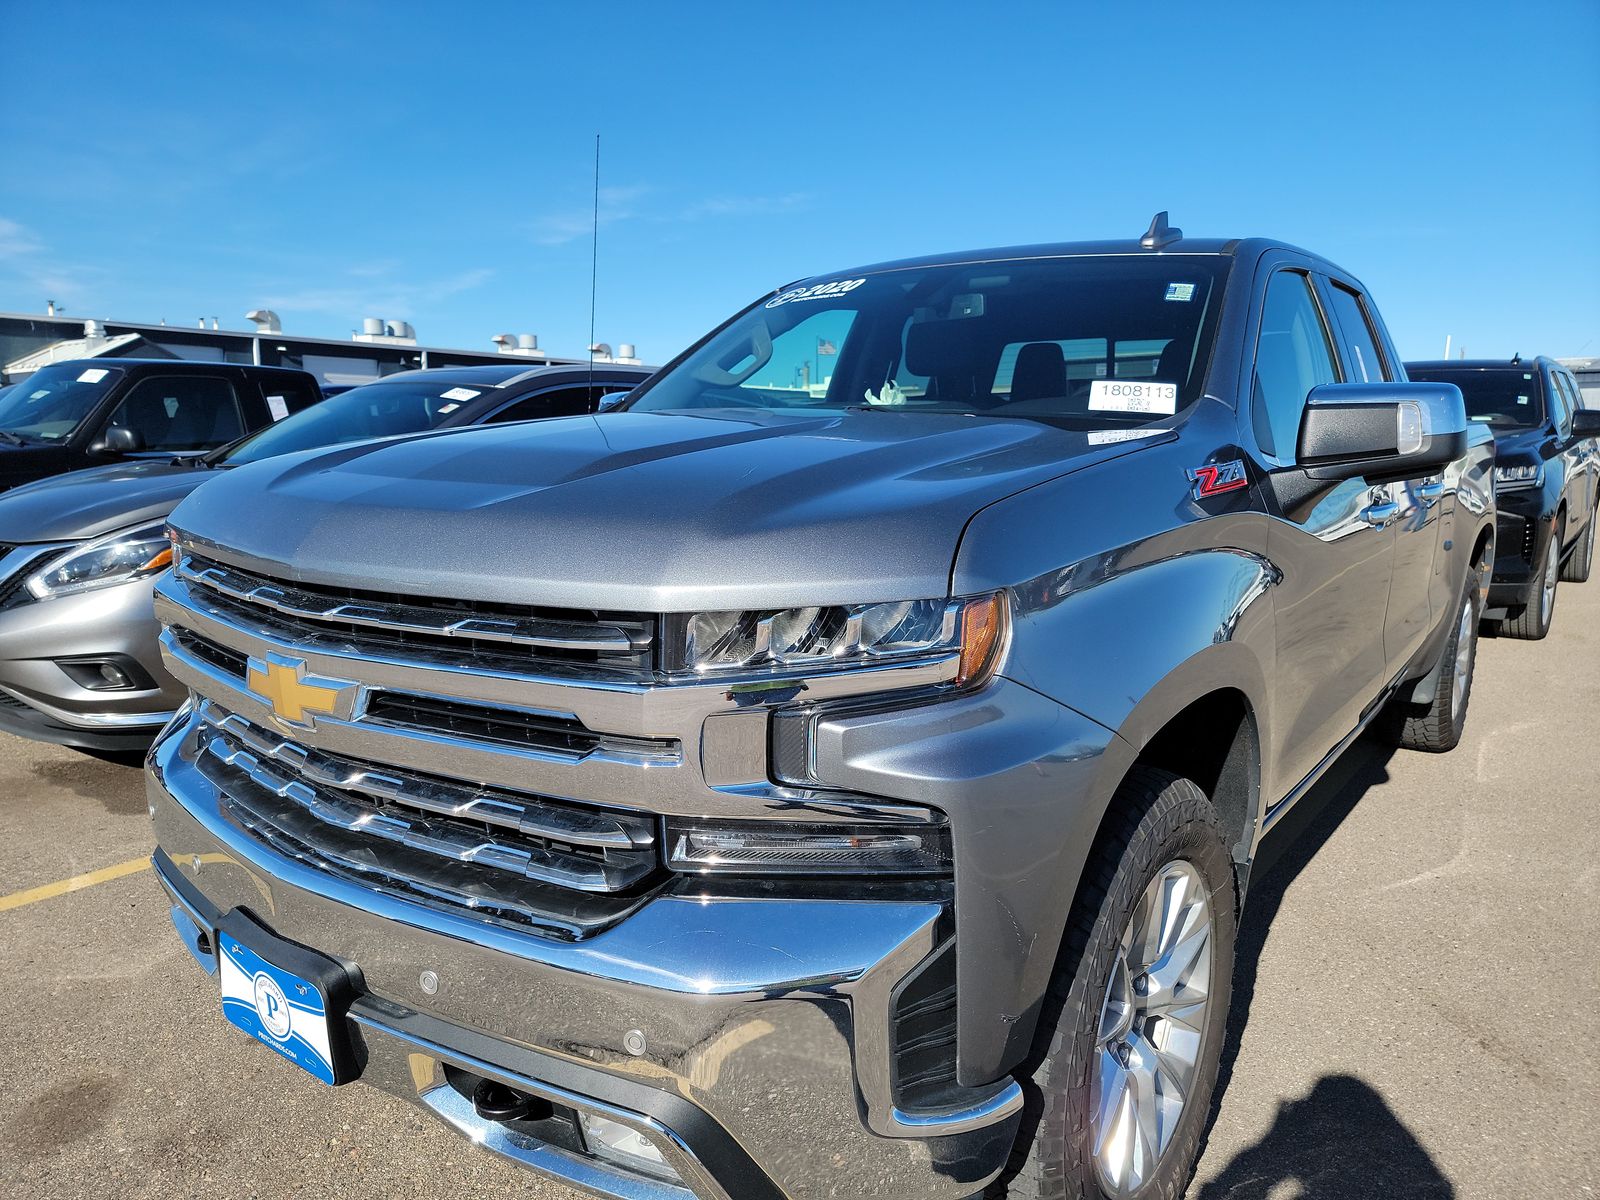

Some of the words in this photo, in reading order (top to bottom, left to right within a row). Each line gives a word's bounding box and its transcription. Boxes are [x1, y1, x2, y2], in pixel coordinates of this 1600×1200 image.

[798, 279, 866, 297] 2020
[1102, 385, 1175, 398] 1808113
[1186, 459, 1248, 500] Z71
[264, 991, 279, 1020] P
